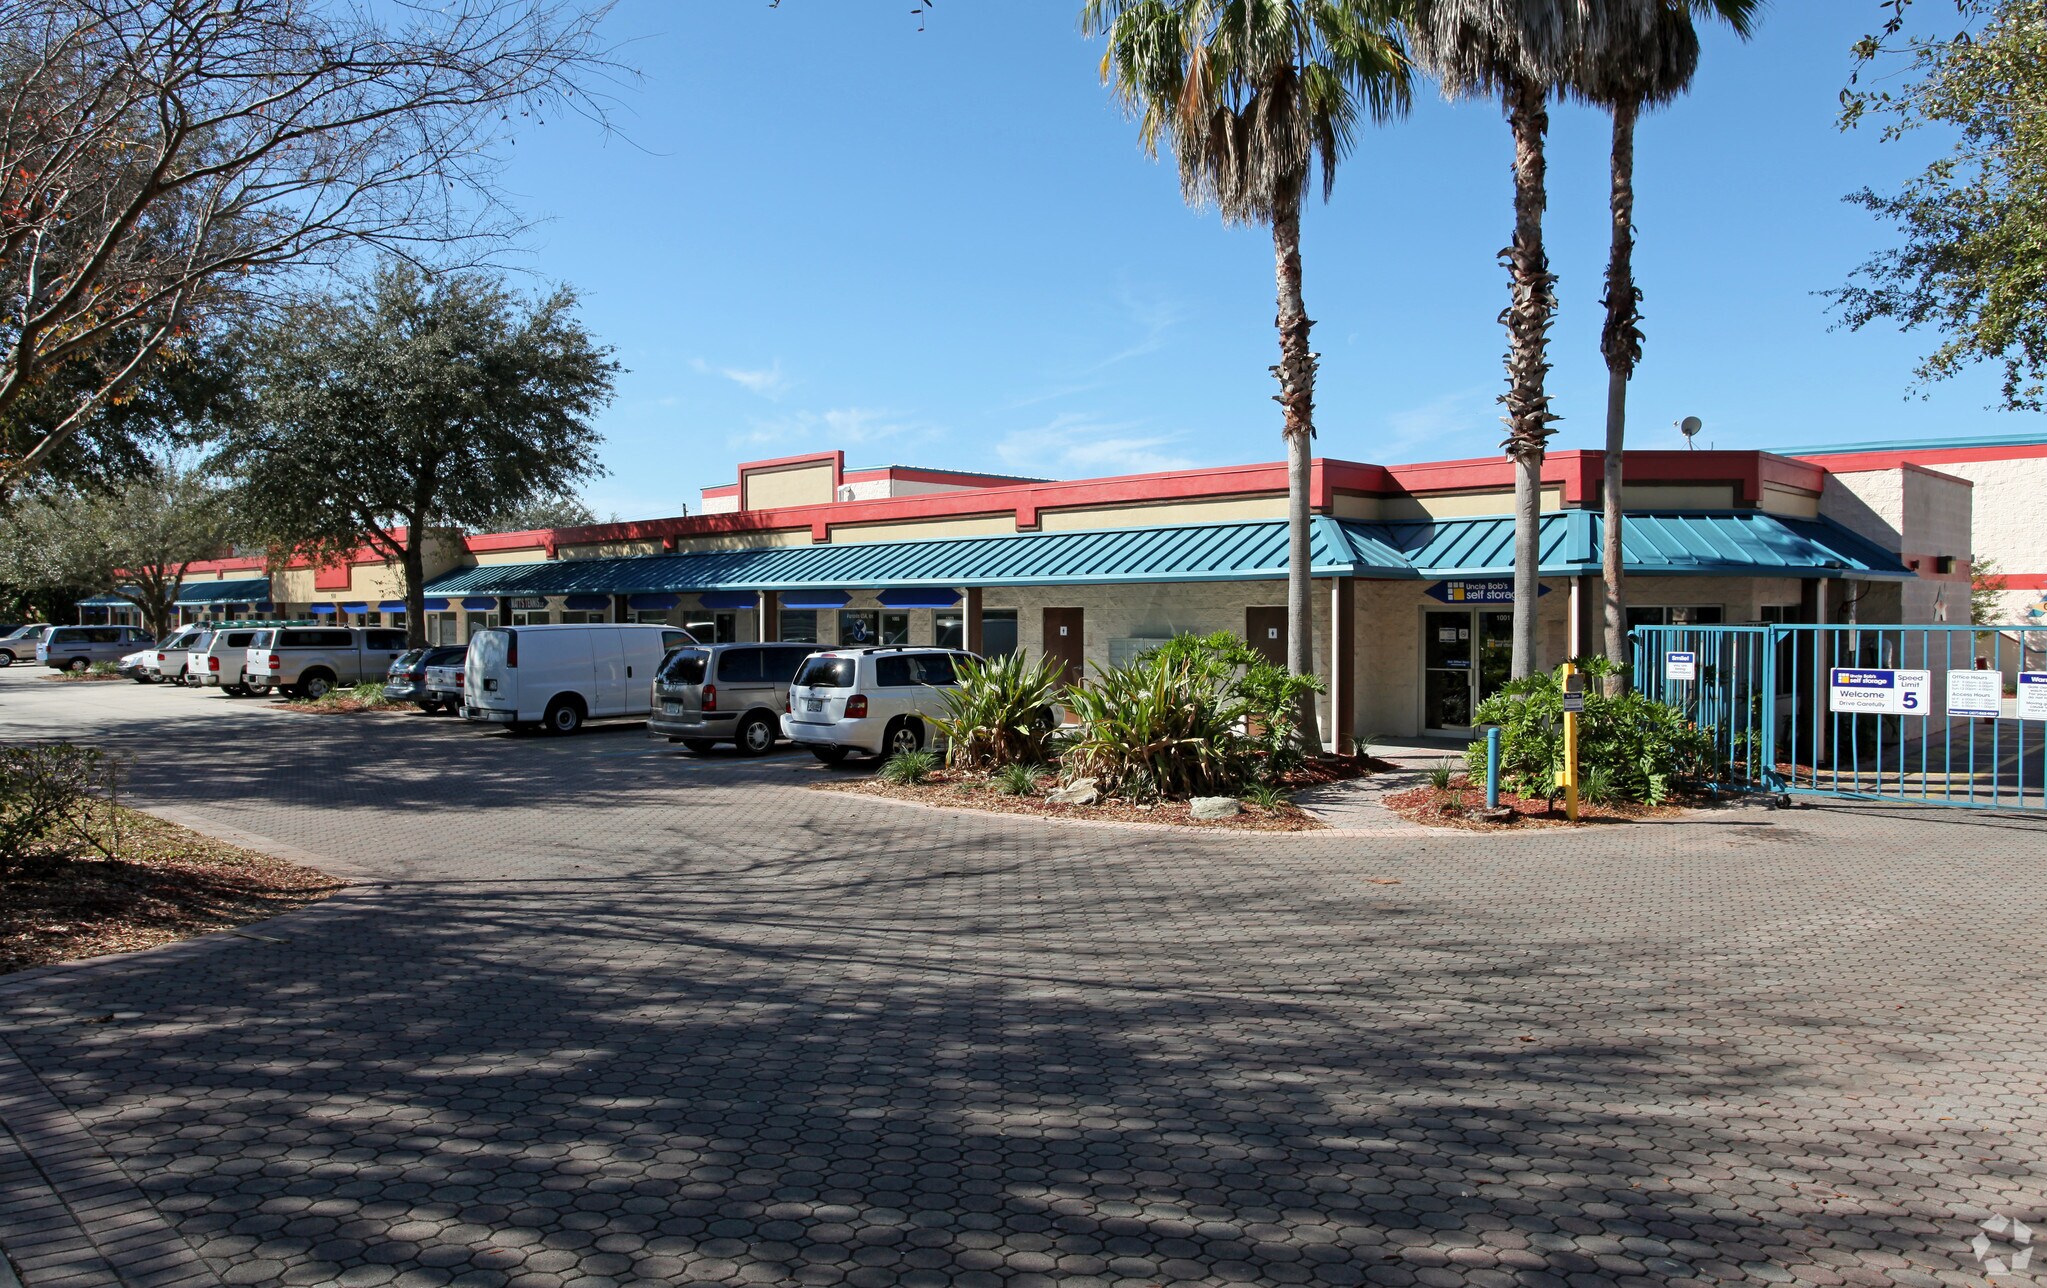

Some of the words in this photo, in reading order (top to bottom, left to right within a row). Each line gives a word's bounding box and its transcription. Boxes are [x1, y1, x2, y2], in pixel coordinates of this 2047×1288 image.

[1488, 582, 1508, 590] Bob's
[1466, 590, 1484, 600] self
[1487, 590, 1515, 601] storag
[1897, 674, 1924, 682] Speed
[1840, 690, 1885, 698] Welcome
[1902, 691, 1918, 709] 5
